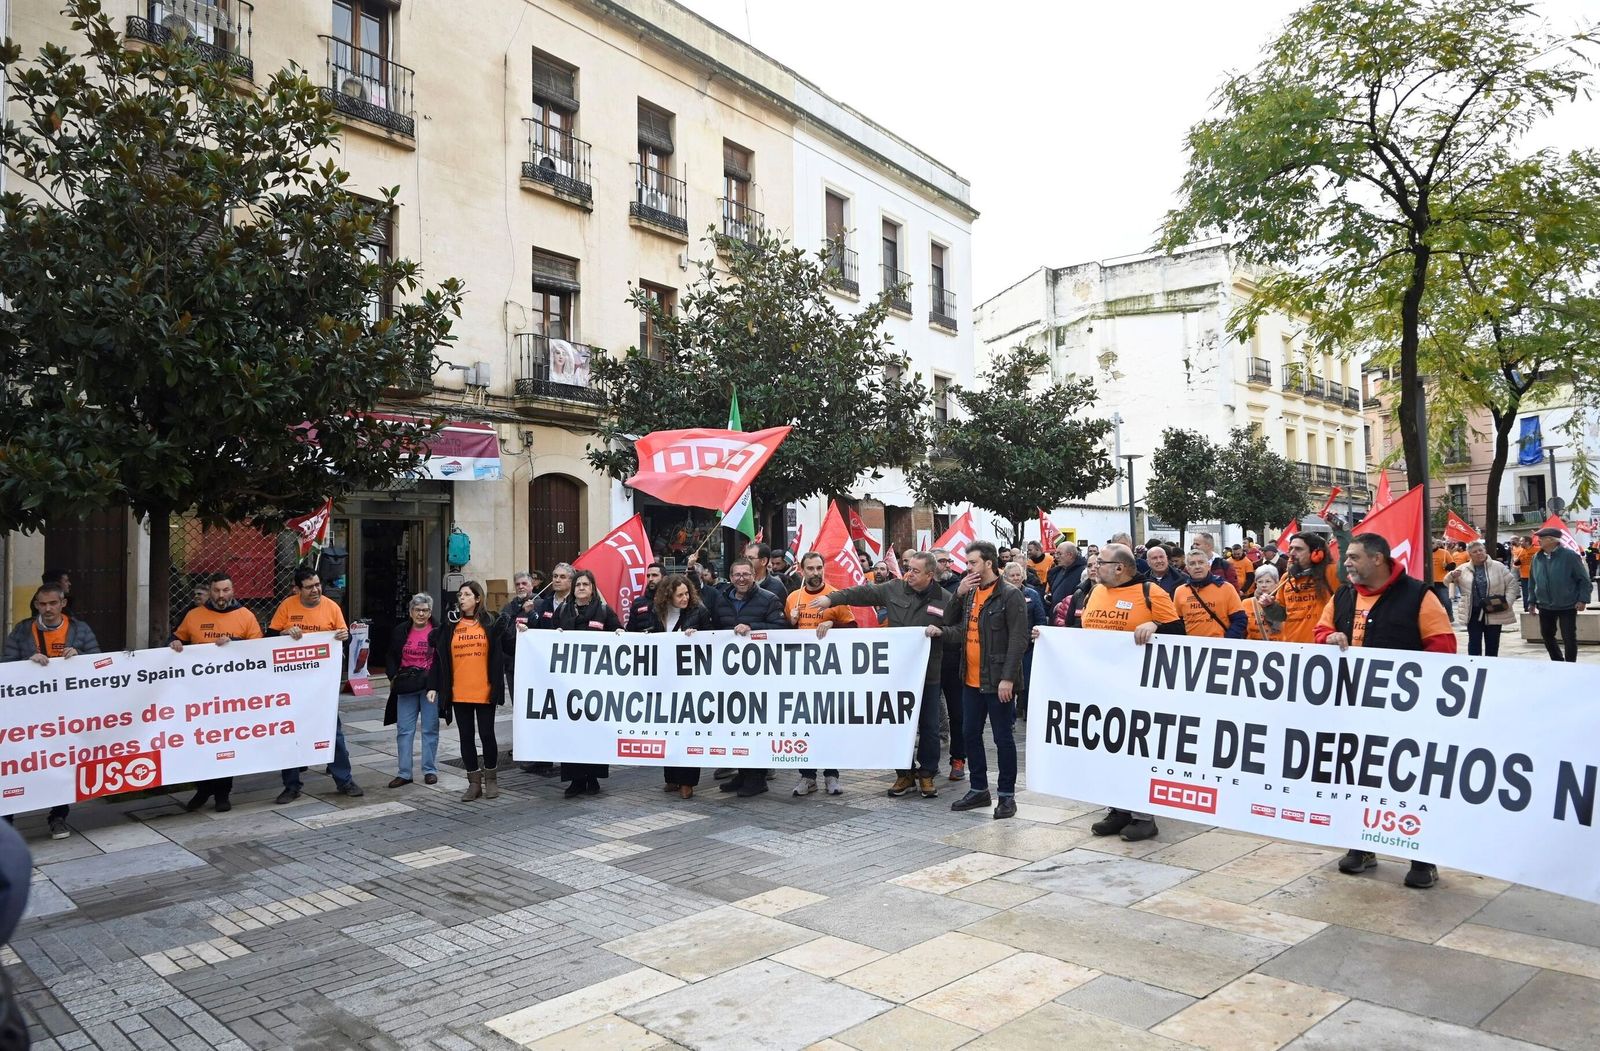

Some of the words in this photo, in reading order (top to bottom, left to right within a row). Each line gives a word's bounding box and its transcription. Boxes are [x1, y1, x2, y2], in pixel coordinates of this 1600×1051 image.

[273, 660, 320, 673] industria
[275, 647, 317, 662] CCOO
[550, 643, 658, 677] HITACHI
[675, 643, 713, 676] EN
[722, 642, 842, 677] CONTRA
[852, 641, 890, 676] DE
[65, 674, 131, 692] Energy
[137, 666, 185, 684] Spain
[191, 658, 267, 677] Córdoba
[1141, 643, 1423, 712] INVERSIONES
[1436, 665, 1487, 719] SI
[142, 703, 175, 723] de
[185, 692, 291, 722] primera
[526, 688, 559, 721] LA
[566, 689, 768, 725] CONCILIACION
[778, 690, 917, 726] FAMILIAR
[1, 739, 141, 776] ndiciones
[151, 731, 184, 750] de
[194, 719, 295, 746] tercera
[620, 741, 663, 755] CCOO
[771, 739, 808, 754] USO
[771, 754, 809, 763] industria
[1045, 700, 1201, 765] RECORTE
[1212, 719, 1268, 775] DE
[1283, 728, 1534, 812] DERECHOS
[79, 757, 157, 796] USO
[1151, 766, 1240, 785] COMITE
[1264, 783, 1290, 794] DE
[1316, 790, 1428, 812] EMPRESA
[1152, 783, 1214, 809] CCOO
[1363, 807, 1421, 836] USO
[1361, 829, 1420, 850] industria
